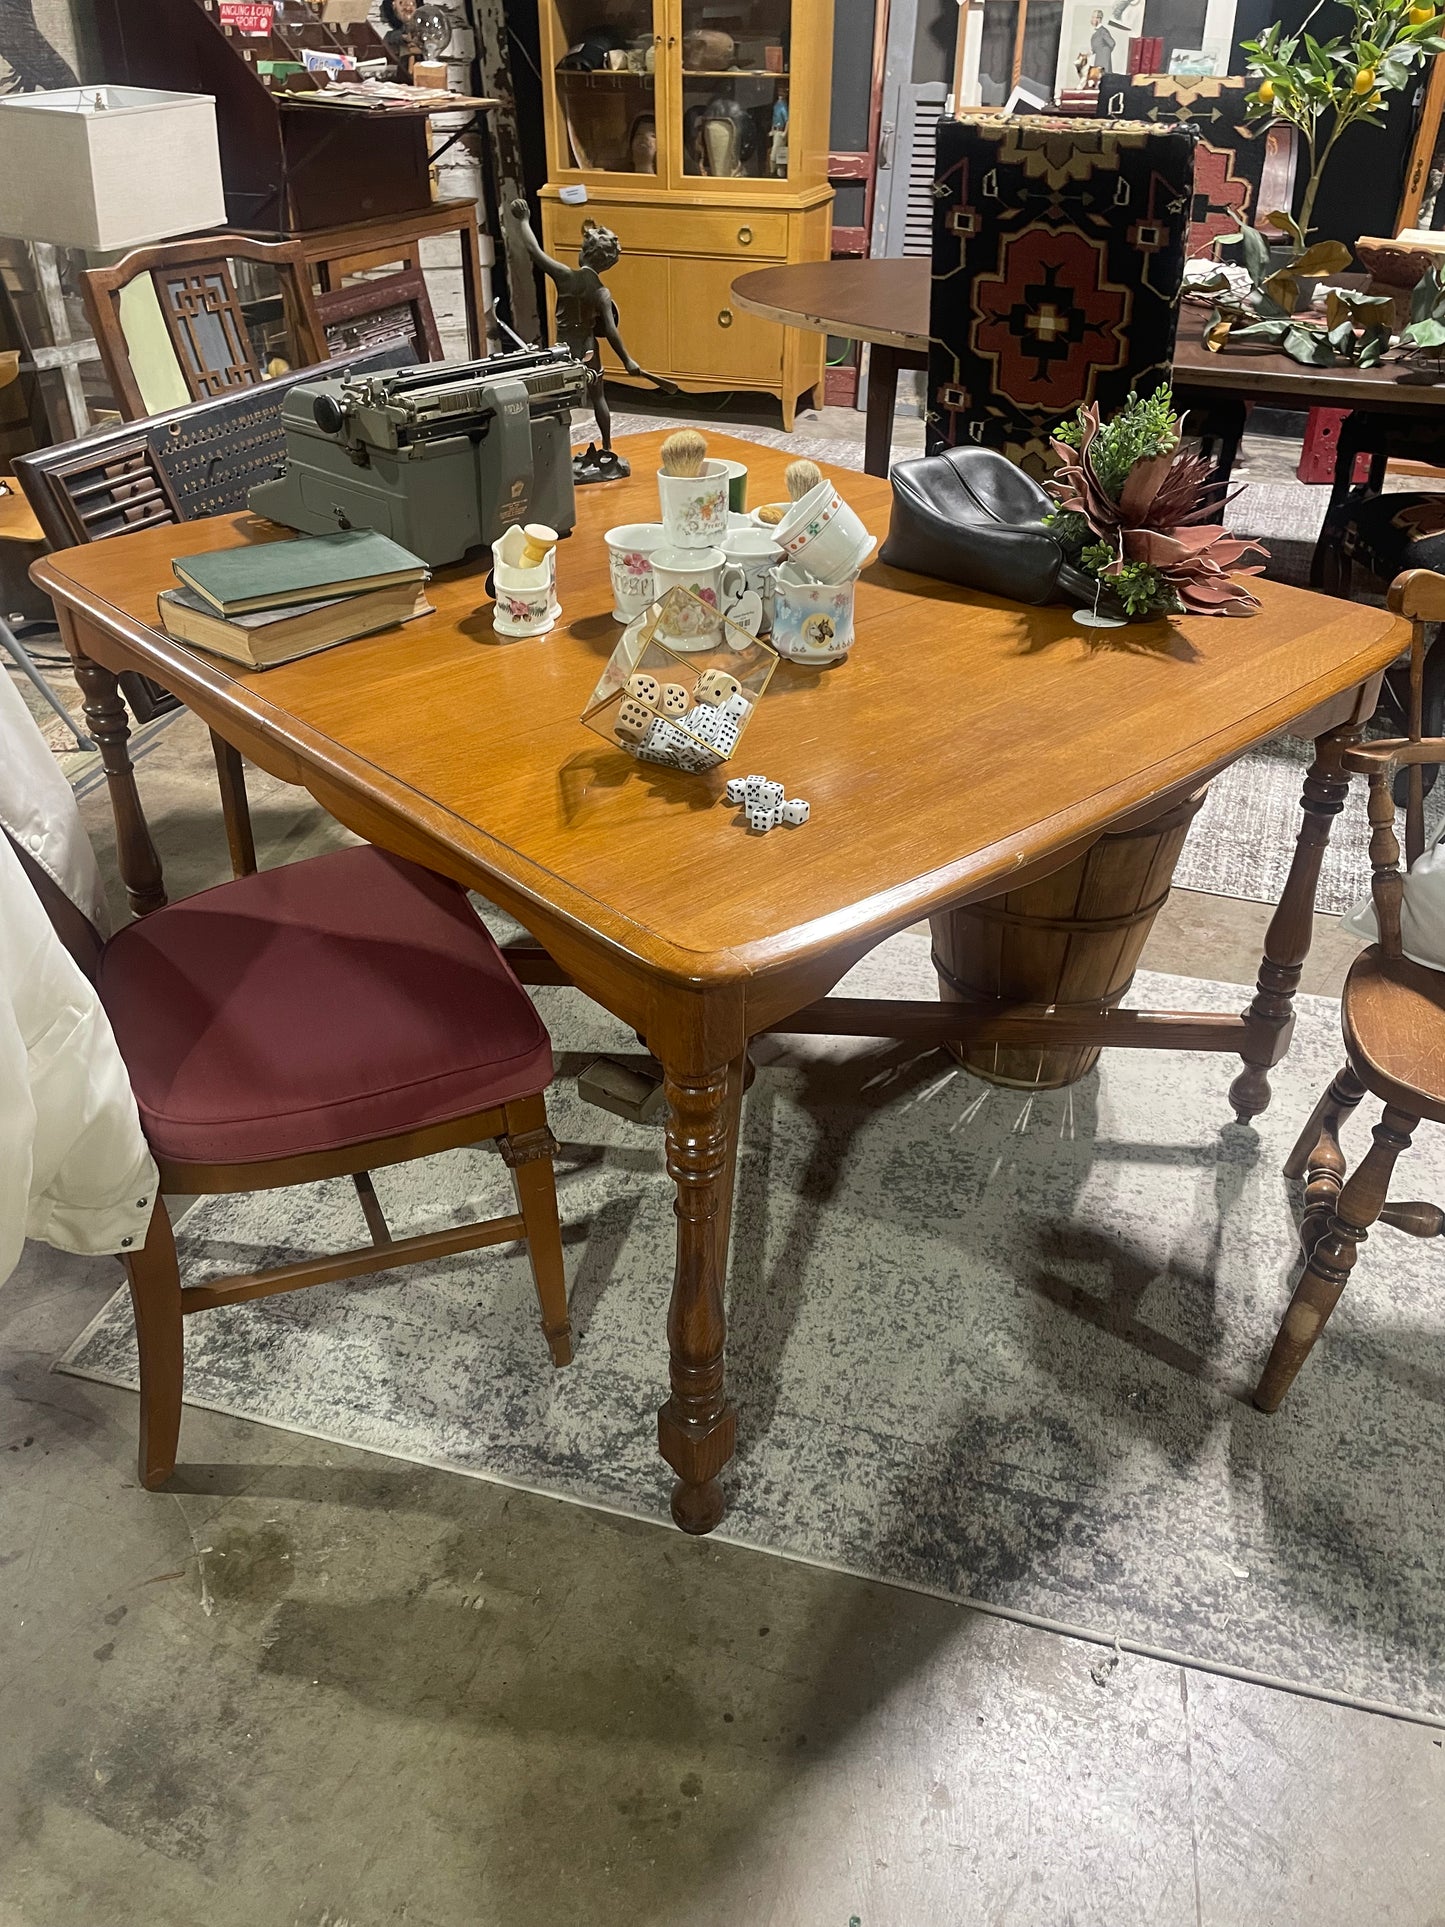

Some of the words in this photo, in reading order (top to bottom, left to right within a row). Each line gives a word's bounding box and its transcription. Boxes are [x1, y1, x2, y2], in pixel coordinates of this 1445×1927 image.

[221, 5, 250, 16] ANGLING
[251, 6, 256, 16] &
[256, 6, 273, 17] GUN
[235, 16, 258, 27] SPORT
